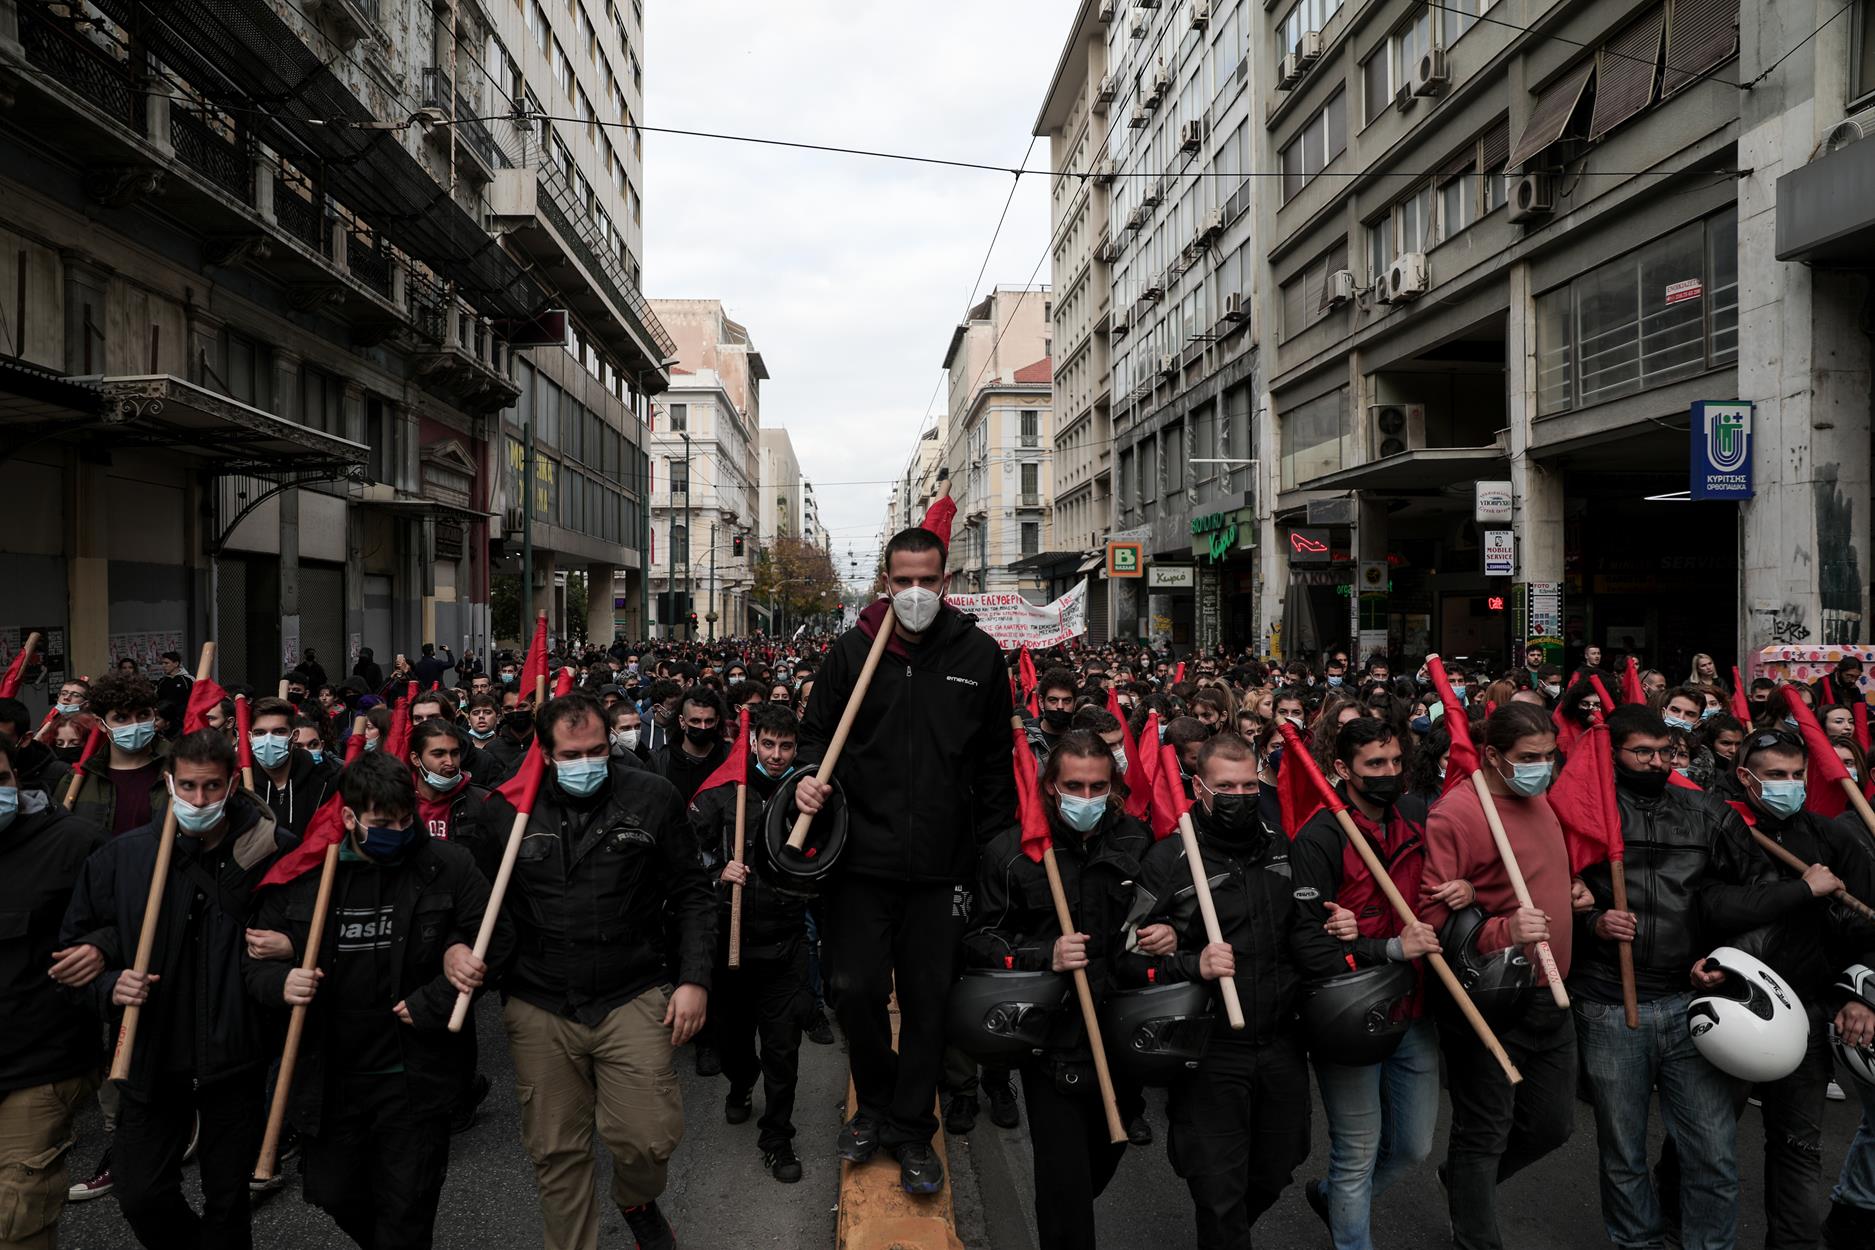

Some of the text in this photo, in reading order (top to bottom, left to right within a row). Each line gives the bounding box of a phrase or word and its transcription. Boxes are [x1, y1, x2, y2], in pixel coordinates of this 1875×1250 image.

[1707, 475, 1746, 483] ΚΥΡΙΤΣΗΣ
[1156, 571, 1186, 584] Χωριό
[946, 675, 978, 687] emerson
